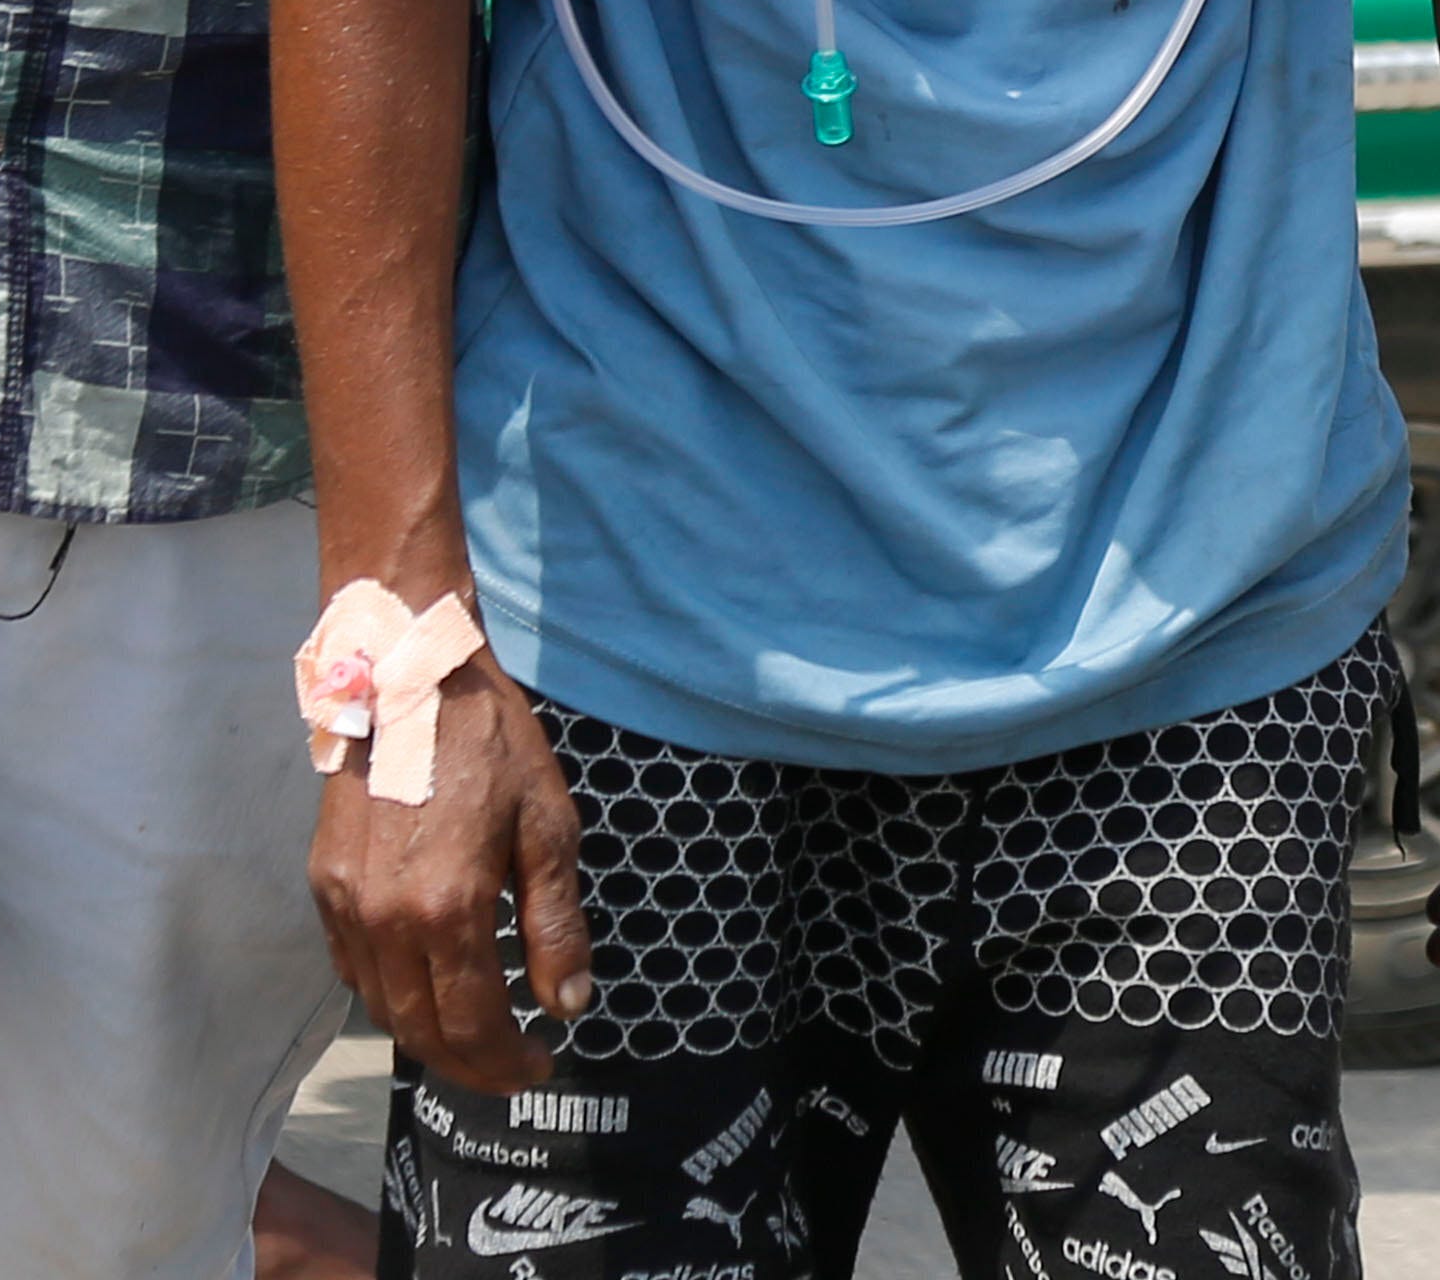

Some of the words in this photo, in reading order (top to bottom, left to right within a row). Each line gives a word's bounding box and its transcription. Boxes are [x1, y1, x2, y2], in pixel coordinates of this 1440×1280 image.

[981, 1050, 1064, 1091] UMA
[1100, 1073, 1212, 1161] PUMA
[488, 1182, 618, 1233] NIKE
[1241, 1193, 1311, 1280] Reebo
